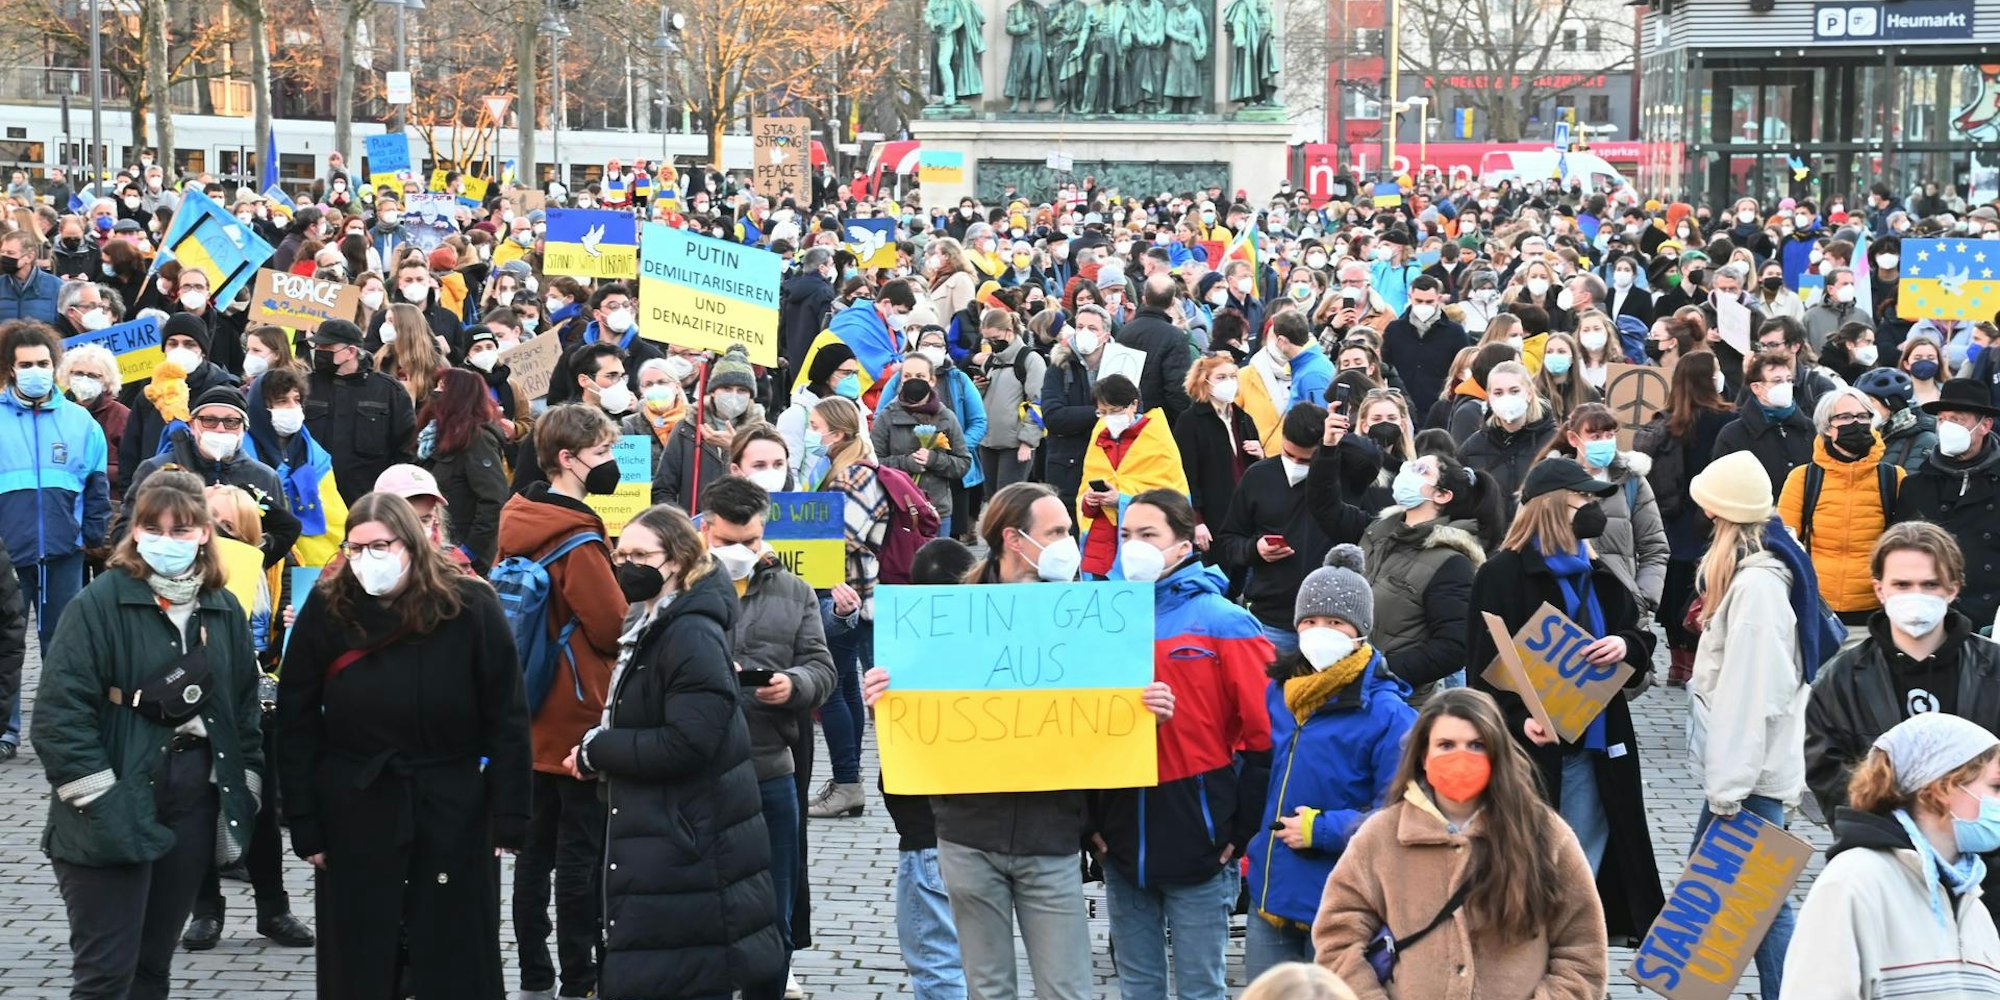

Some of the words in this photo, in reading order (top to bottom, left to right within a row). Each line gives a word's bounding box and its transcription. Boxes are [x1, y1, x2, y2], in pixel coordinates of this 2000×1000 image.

[1887, 12, 1966, 28] Heumarkt
[758, 164, 799, 178] PEACE
[763, 179, 773, 191] 4
[779, 179, 794, 191] the
[546, 253, 575, 270] STAND
[600, 253, 634, 275] UKRAINE
[686, 241, 739, 269] PUTIN
[644, 259, 774, 303] DEMILITARISIEREN
[695, 297, 726, 314] UND
[123, 323, 158, 349] WAR
[652, 307, 765, 345] DENAZIFIZIEREN
[593, 505, 632, 514] trennen
[789, 501, 830, 523] WITH
[894, 592, 1016, 640] KEIN
[1052, 588, 1134, 634] GAS
[984, 642, 1066, 688] AUS
[1524, 615, 1618, 689] STOP
[888, 693, 1137, 746] RUSSLAND
[1635, 879, 1721, 992] STAND
[1690, 809, 1765, 885] WITH
[1687, 839, 1795, 984] UKRAINE
